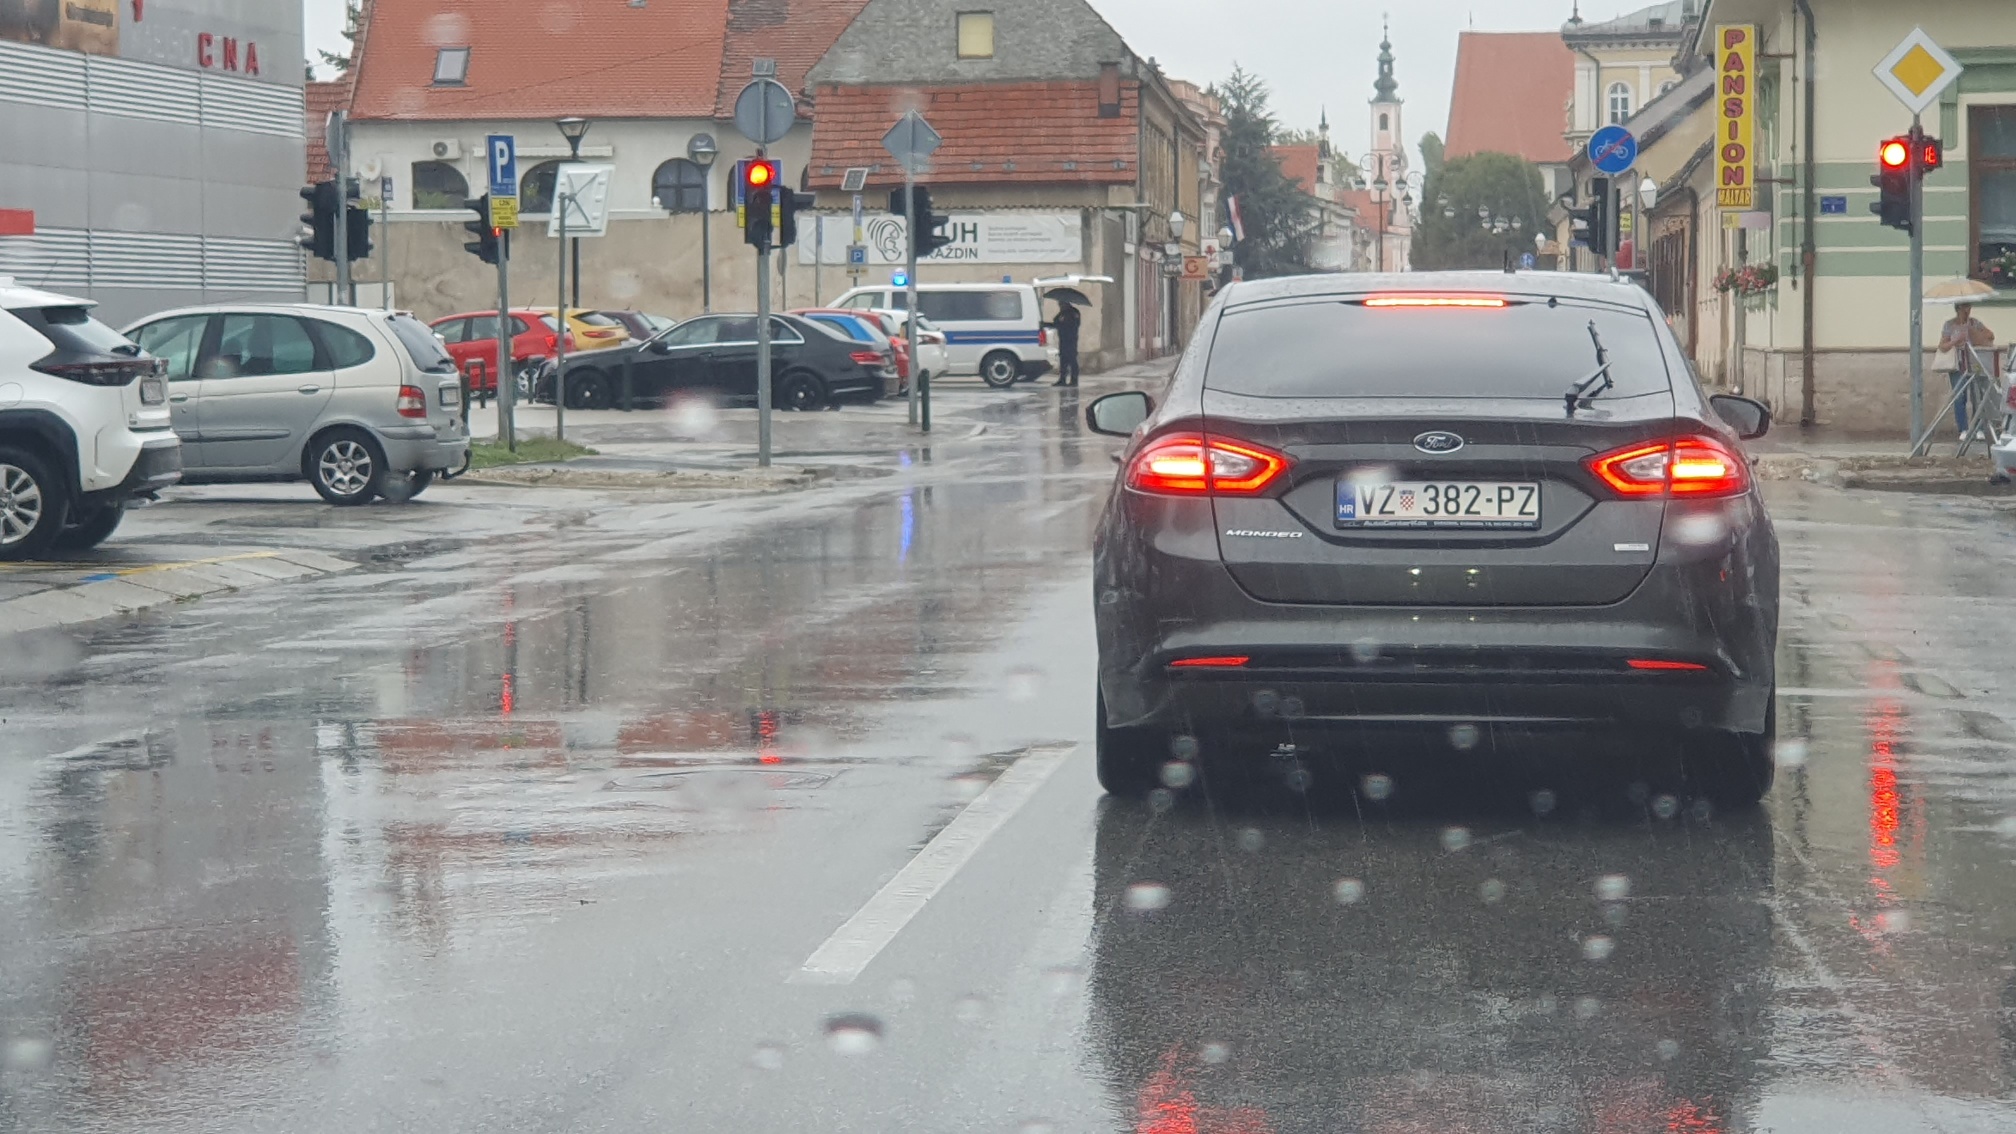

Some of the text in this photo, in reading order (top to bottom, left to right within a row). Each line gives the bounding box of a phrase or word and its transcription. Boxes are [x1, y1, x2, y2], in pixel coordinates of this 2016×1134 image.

[197, 32, 261, 76] CNA
[1721, 28, 1746, 187] PANSION
[495, 141, 509, 183] P
[853, 251, 862, 261] P
[1424, 435, 1453, 449] Ford
[1339, 504, 1354, 515] HR
[1423, 484, 1536, 516] 382-PZ
[1226, 529, 1303, 538] MONDEO
